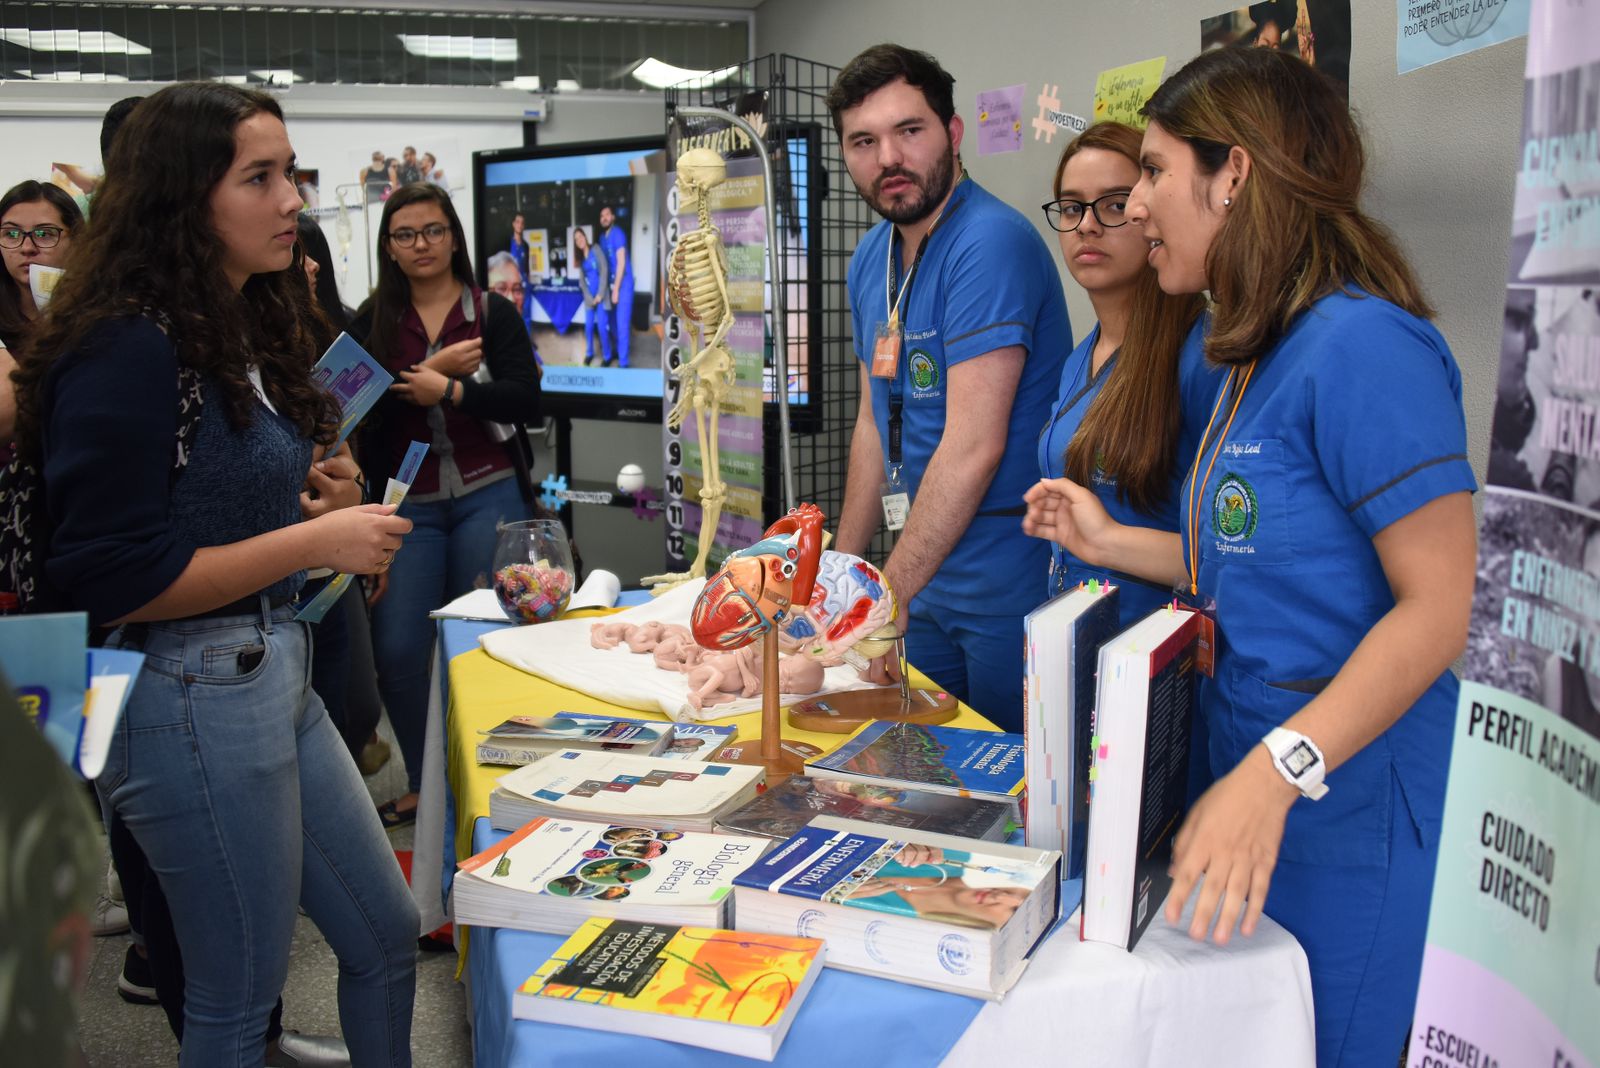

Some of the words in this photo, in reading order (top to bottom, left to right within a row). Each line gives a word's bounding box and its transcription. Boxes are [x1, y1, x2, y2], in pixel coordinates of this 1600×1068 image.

[1404, 19, 1428, 37] PODER
[1431, 3, 1470, 28] ENTENDER
[671, 222, 678, 243] 2
[669, 317, 679, 339] 5
[669, 348, 681, 370] 6
[668, 380, 681, 404] 7
[669, 442, 681, 467] 9
[667, 474, 684, 495] 10
[670, 505, 683, 526] 11
[668, 535, 685, 557] 12
[1502, 596, 1531, 641] EN
[1468, 701, 1535, 760] PERFIL
[973, 743, 1009, 769] Humana
[693, 843, 750, 885] Biología
[794, 838, 864, 887] ENFERMERÍA
[1481, 811, 1555, 886] CUIDADO
[656, 859, 693, 893] general
[1479, 858, 1552, 933] DIRECTO
[582, 932, 631, 974] EDUCATIVA
[591, 926, 655, 986] INVESTIGACIÓN
[626, 932, 666, 970] MÉTODOS
[613, 970, 633, 983] DE
